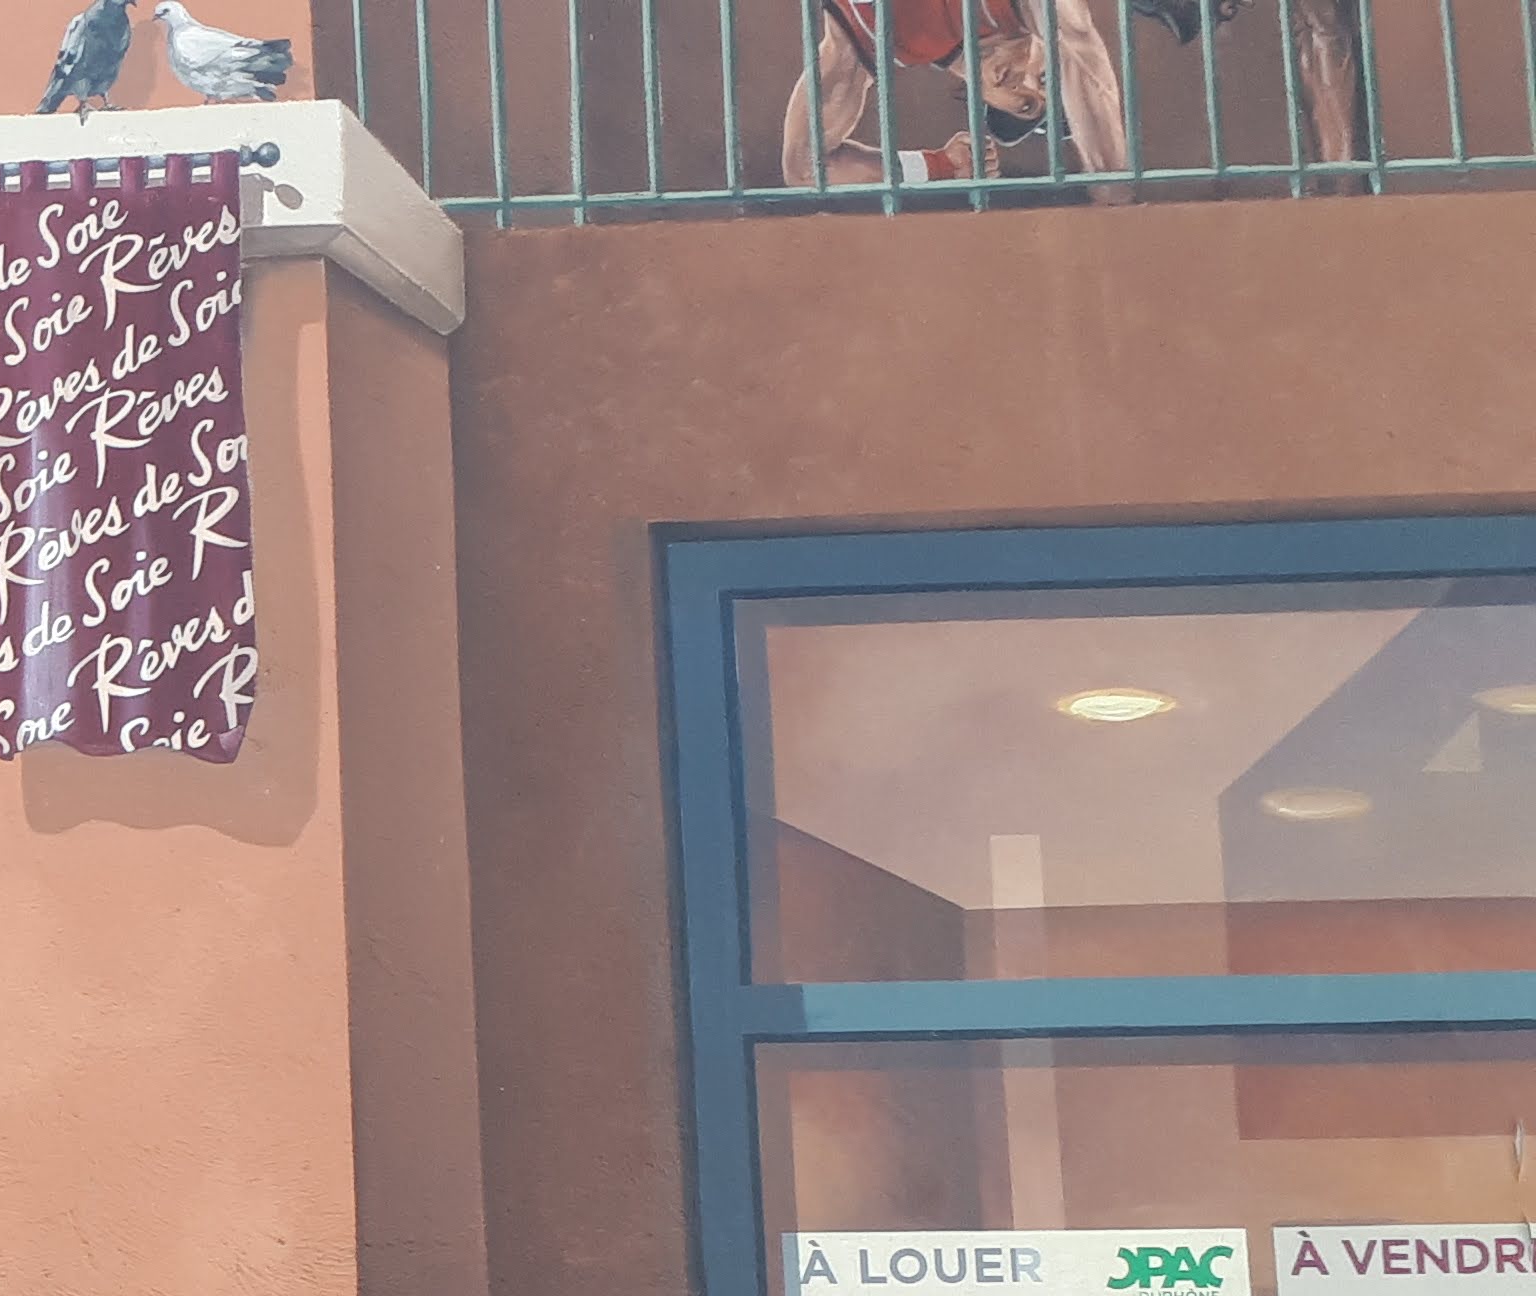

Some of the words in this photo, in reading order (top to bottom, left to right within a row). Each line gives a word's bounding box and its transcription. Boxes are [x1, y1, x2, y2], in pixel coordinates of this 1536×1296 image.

[36, 197, 129, 269] Soie
[4, 292, 93, 366] Soie
[112, 324, 163, 380] de
[133, 463, 184, 518] de
[23, 601, 75, 657] de
[82, 551, 173, 628] Soie
[800, 1240, 837, 1285] À
[860, 1247, 1043, 1284] LOUER
[1291, 1230, 1329, 1275] À
[1341, 1238, 1536, 1275] VENDR
